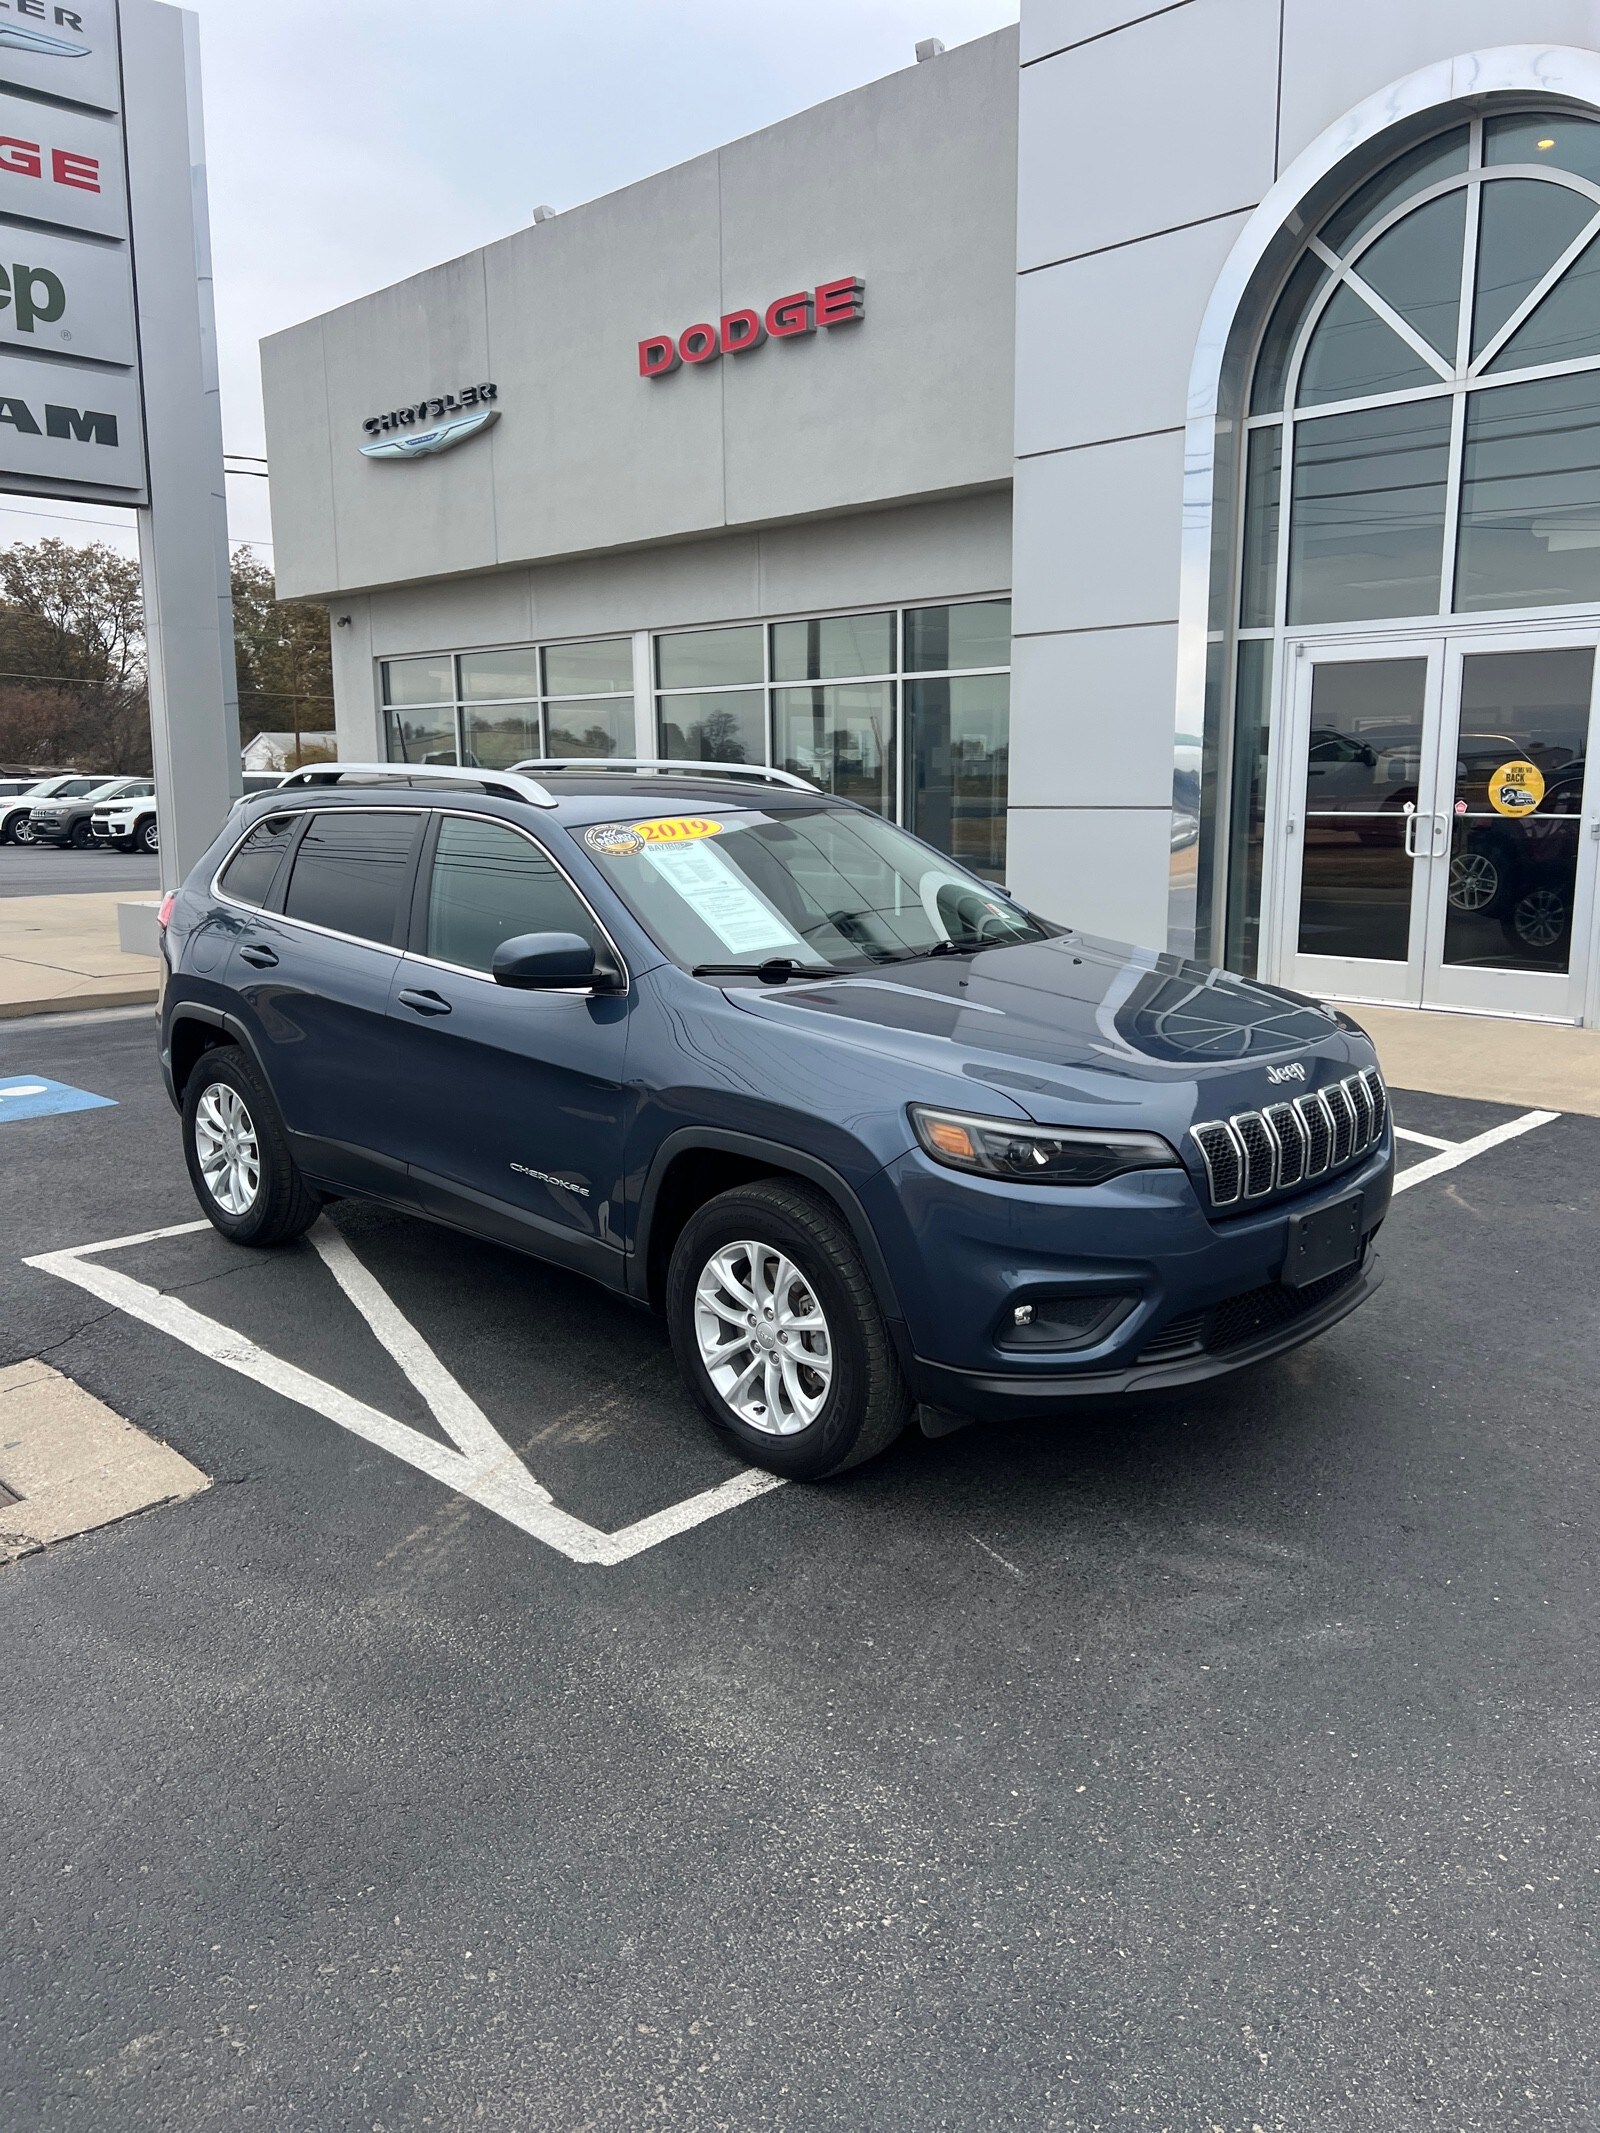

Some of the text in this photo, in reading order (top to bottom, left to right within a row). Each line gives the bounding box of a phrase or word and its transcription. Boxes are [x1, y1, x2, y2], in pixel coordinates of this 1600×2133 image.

[0, 0, 83, 32] ER
[638, 276, 866, 378] DODGE
[362, 382, 498, 434] CHRYSLER
[1506, 773, 1525, 782] BACK
[639, 820, 708, 841] 2019
[1266, 1062, 1306, 1084] Jeep
[509, 1162, 590, 1197] CHEROKEE
